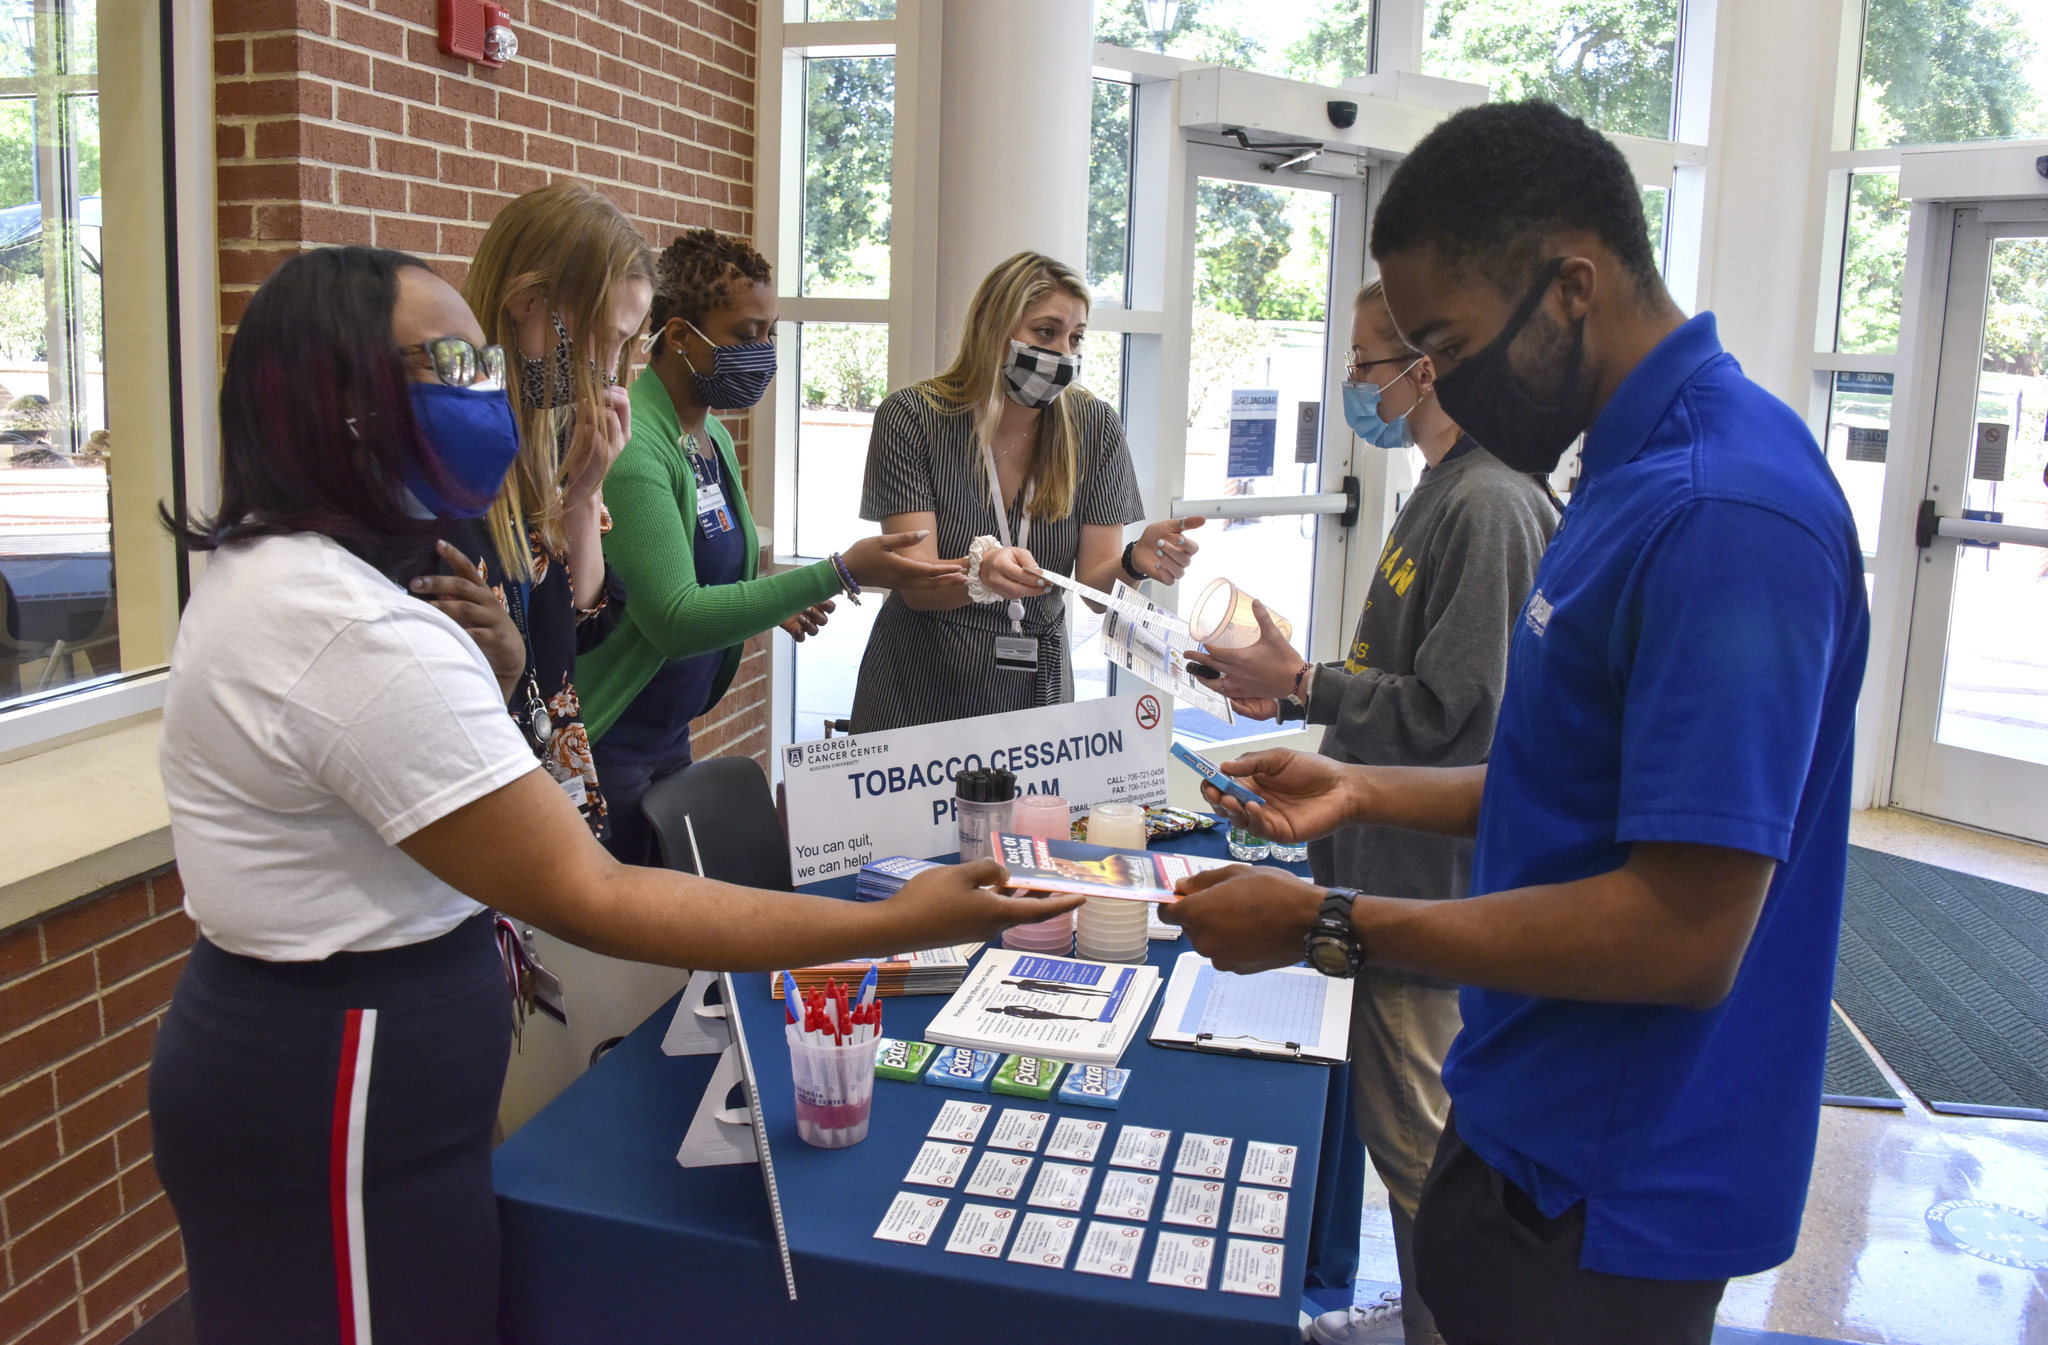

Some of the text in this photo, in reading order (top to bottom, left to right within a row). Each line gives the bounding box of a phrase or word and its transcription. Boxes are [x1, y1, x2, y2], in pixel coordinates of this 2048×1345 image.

[498, 11, 510, 20] FIRE
[807, 739, 857, 754] GEORGIA
[808, 744, 889, 764] CANCER CENTER
[832, 760, 859, 769] UNIVERSITY
[848, 729, 1124, 799] TOBACCO CESSATION
[1196, 761, 1217, 779] Extra
[1107, 768, 1165, 786] CALL: 706-721-0456
[1112, 778, 1165, 794] FAX: 706-721-5416
[796, 834, 873, 858] You can quit,
[1002, 836, 1020, 864] Cost Of
[1019, 838, 1035, 869] Smoking
[1037, 840, 1049, 871] Calculator
[797, 851, 872, 878] we can help!
[961, 995, 974, 1004] Health
[968, 985, 981, 995] Effects
[982, 964, 997, 977] Smoking
[883, 1040, 908, 1069] Extra
[949, 1048, 972, 1078] Extra
[1014, 1056, 1038, 1086] Extra
[1082, 1065, 1106, 1096] Extra
[1928, 1200, 1995, 1222] DISTANCE
[1955, 1242, 2008, 1264] KEEP
